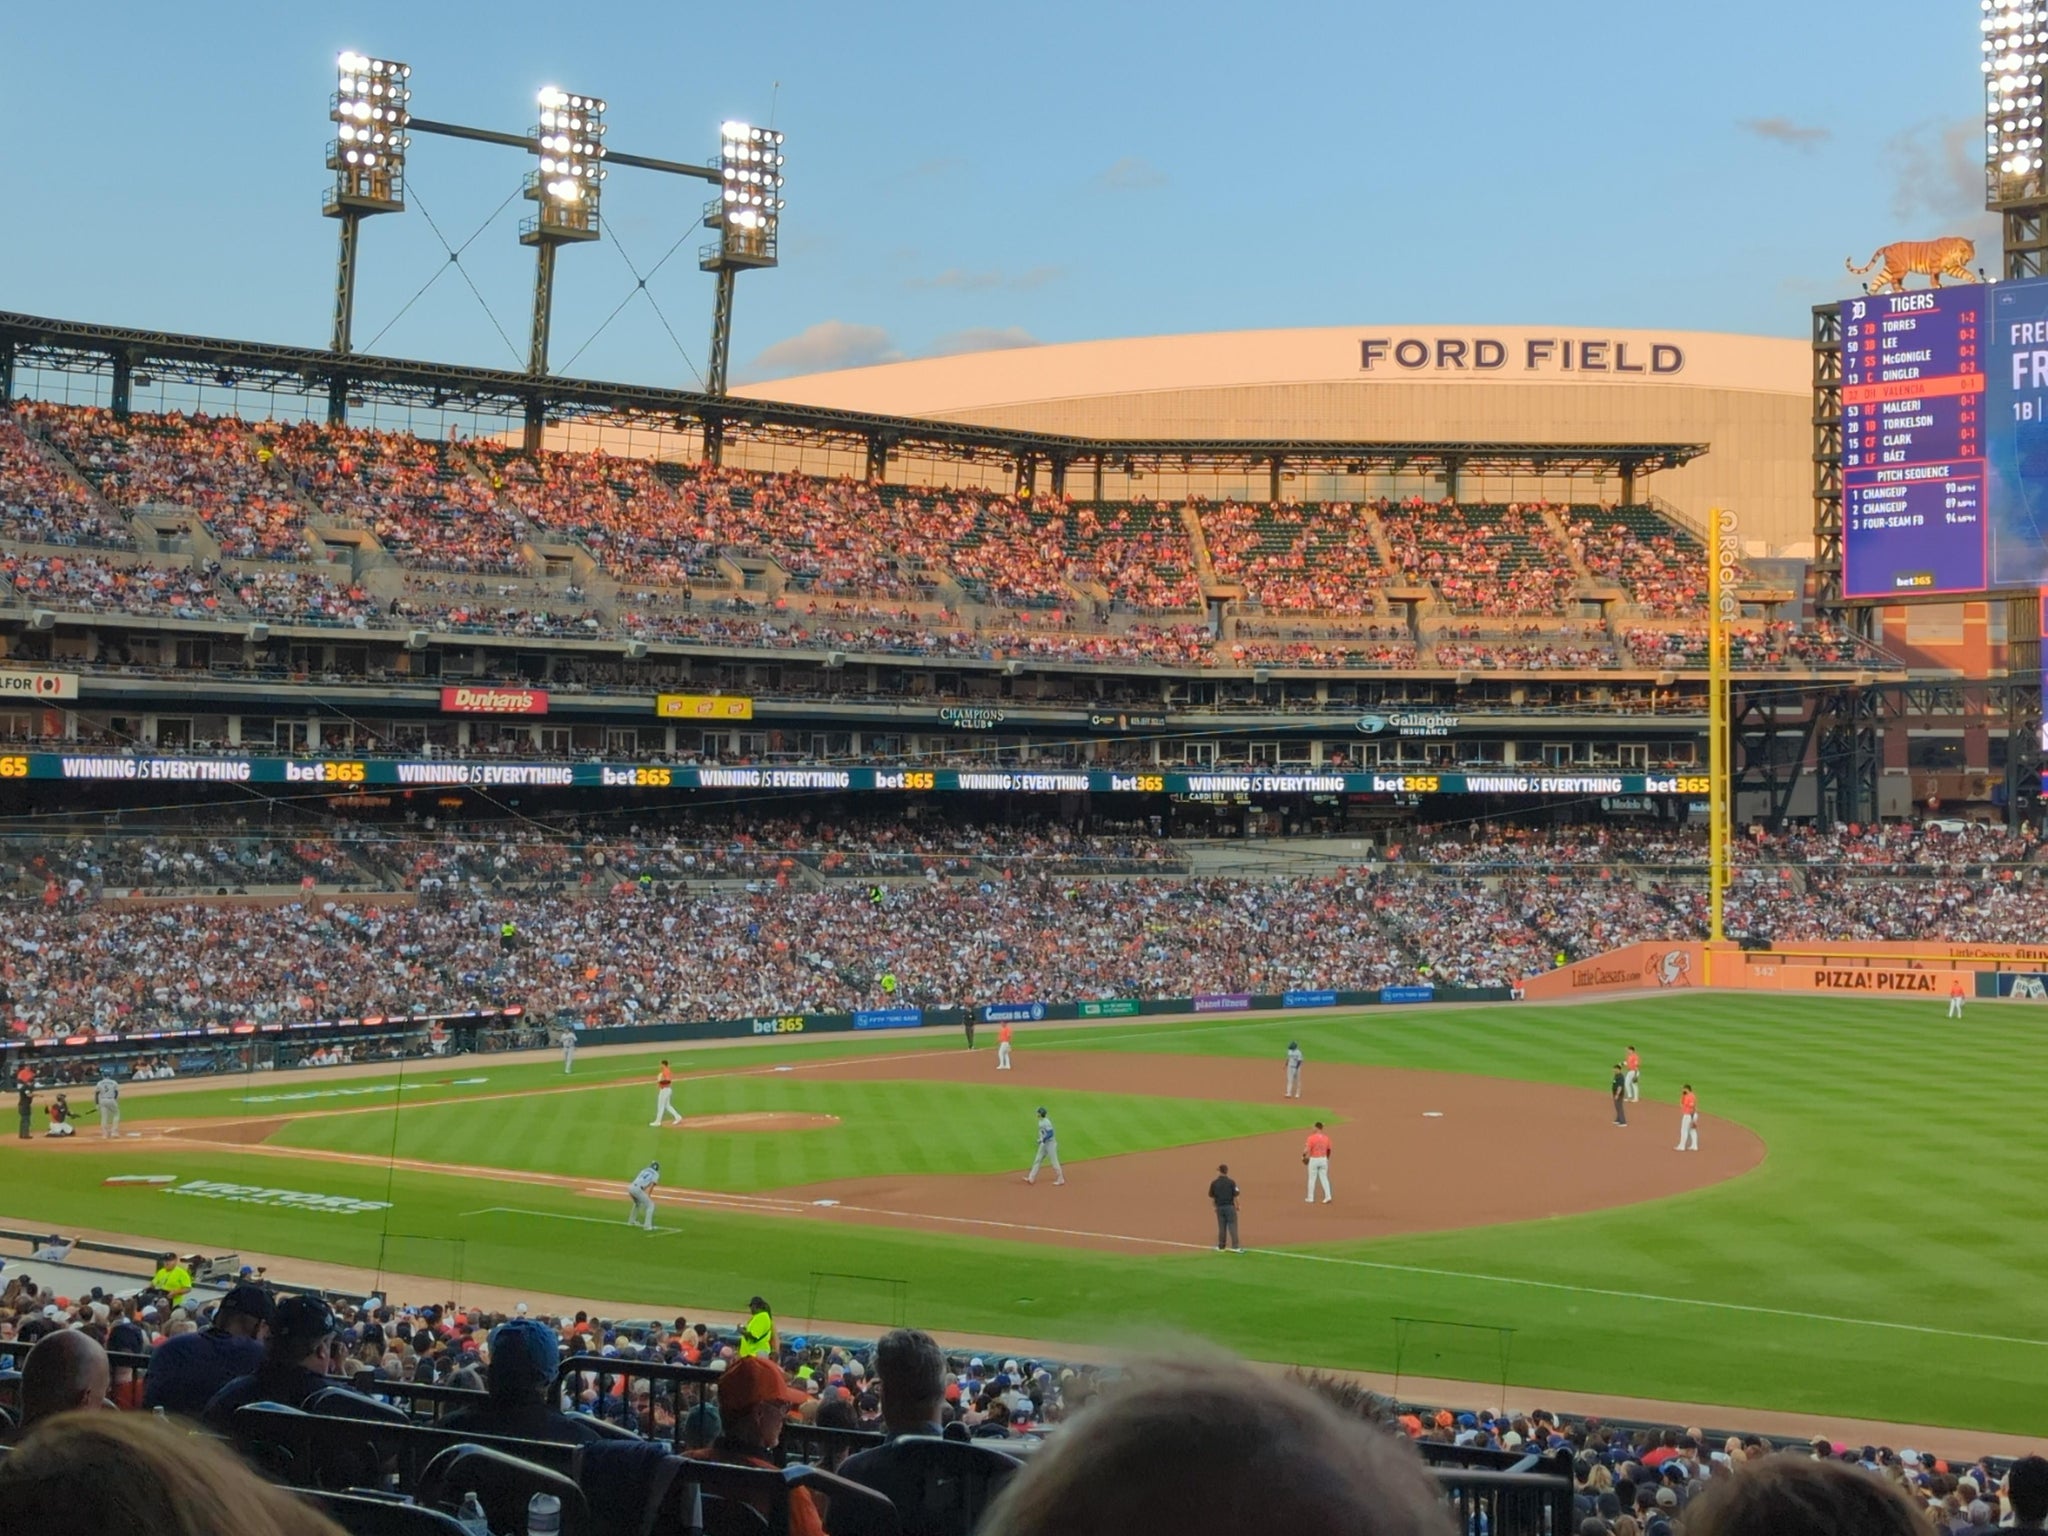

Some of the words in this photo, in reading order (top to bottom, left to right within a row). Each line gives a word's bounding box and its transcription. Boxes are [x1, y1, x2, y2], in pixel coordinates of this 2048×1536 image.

[1890, 293, 1934, 313] TIGERS
[1847, 325, 1858, 337] 25
[1864, 323, 1876, 335] 2B
[1882, 319, 1916, 333] TORRES
[1960, 311, 1975, 324] 1-2
[1847, 341, 1858, 353] 50
[1882, 337, 1898, 349] LEE
[1960, 328, 1975, 340] 0-2
[1359, 337, 1508, 372] FORD
[1524, 337, 1686, 375] FIELD
[1850, 357, 1856, 369] 7
[1864, 355, 1876, 367] SS
[1882, 349, 1932, 365] McGONIGLE
[1960, 344, 1975, 357] 0-2
[1867, 372, 1873, 383] C
[1882, 367, 1919, 381] DINGLER
[1960, 361, 1975, 374] 0-2
[1883, 384, 1925, 397] VALENCIA
[1960, 379, 1975, 390] 0-1
[1864, 403, 1876, 415] RF
[1883, 399, 1921, 414] MALGERI
[1960, 395, 1975, 406] 0-1
[2013, 402, 2033, 421] 1B
[1847, 421, 1859, 433] 20
[1865, 420, 1876, 432] 1B
[1883, 415, 1933, 430] TORKELSON
[1960, 411, 1975, 422] 0-1
[1848, 437, 1859, 449] 15
[1864, 436, 1876, 448] CF
[1883, 433, 1912, 446] CLARK
[1960, 428, 1975, 440] 0-1
[1865, 452, 1876, 464] LF
[1883, 449, 1906, 463] BÁEZ
[1960, 445, 1976, 456] 0-1
[1877, 469, 1903, 482] PITCH
[1904, 466, 1950, 479] SEQUENCE
[1853, 489, 1858, 501] 1
[1863, 486, 1908, 500] CHANGEUP
[1945, 483, 1956, 493] 90
[1852, 504, 1859, 515] 2
[1863, 501, 1908, 514] CHANGEUP
[1852, 519, 1859, 530] 3
[1863, 516, 1912, 529] FOUR-SEAM
[1912, 515, 1924, 526] FB
[1945, 512, 1956, 524] 94
[1719, 535, 1738, 623] Rocket
[1896, 576, 1931, 586] bet365
[455, 688, 533, 708] Dunham's
[940, 707, 1004, 722] CHAMPIONS
[1388, 714, 1460, 729] Gallagher
[961, 719, 987, 729] CLUB
[1400, 728, 1448, 736] INSURANCE
[62, 758, 136, 778] WINNING
[137, 759, 150, 779] IS
[151, 760, 250, 780] EVERYTHING
[286, 761, 365, 781] bet365
[398, 764, 468, 784] WINNING
[470, 765, 483, 784] IS
[484, 766, 573, 785] EVERYTHING
[603, 767, 671, 786] bet365
[699, 770, 760, 787] WINNING
[761, 771, 772, 788] IS
[773, 771, 849, 788] EVERYTHING
[875, 771, 934, 789] bet365
[958, 774, 1011, 790] WINNING
[1012, 774, 1022, 790] IS
[1022, 774, 1089, 791] EVERYTHING
[1112, 775, 1163, 792] bet365
[1188, 776, 1250, 792] WINNING
[1251, 776, 1262, 792] IS
[1263, 776, 1345, 792] EVERYTHING
[1373, 776, 1439, 792] bet365
[1466, 777, 1528, 793] WINNING
[1528, 777, 1540, 793] IS
[1541, 777, 1622, 793] EVERYTHING
[1645, 777, 1710, 793] bet365
[1815, 971, 1872, 988] PIZZA!
[1877, 972, 1936, 991] PIZZA!
[753, 1018, 803, 1033] bet365
[179, 1180, 394, 1211] VICTORS
